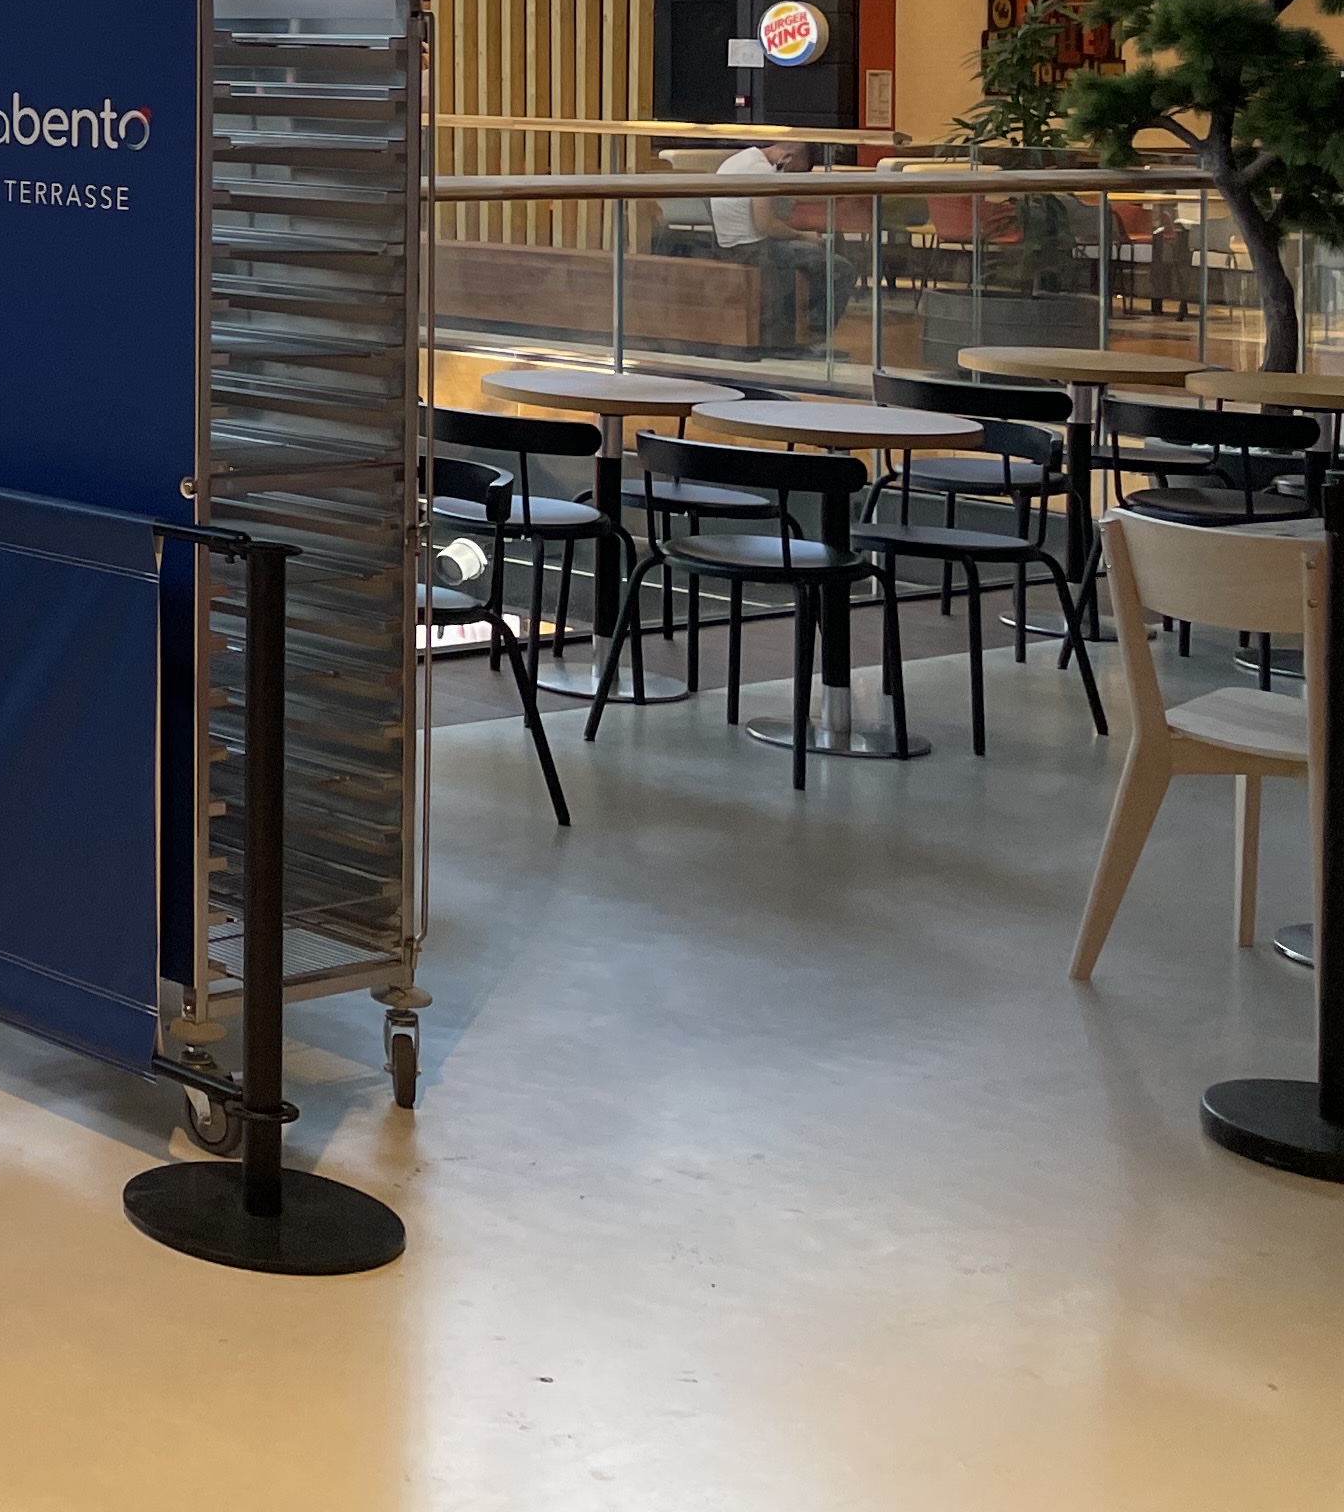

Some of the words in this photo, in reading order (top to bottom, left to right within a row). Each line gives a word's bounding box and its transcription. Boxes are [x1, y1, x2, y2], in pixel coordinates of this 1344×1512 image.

[764, 12, 808, 37] BURGER
[767, 22, 811, 54] KING
[4, 179, 130, 211] TERRASSE
